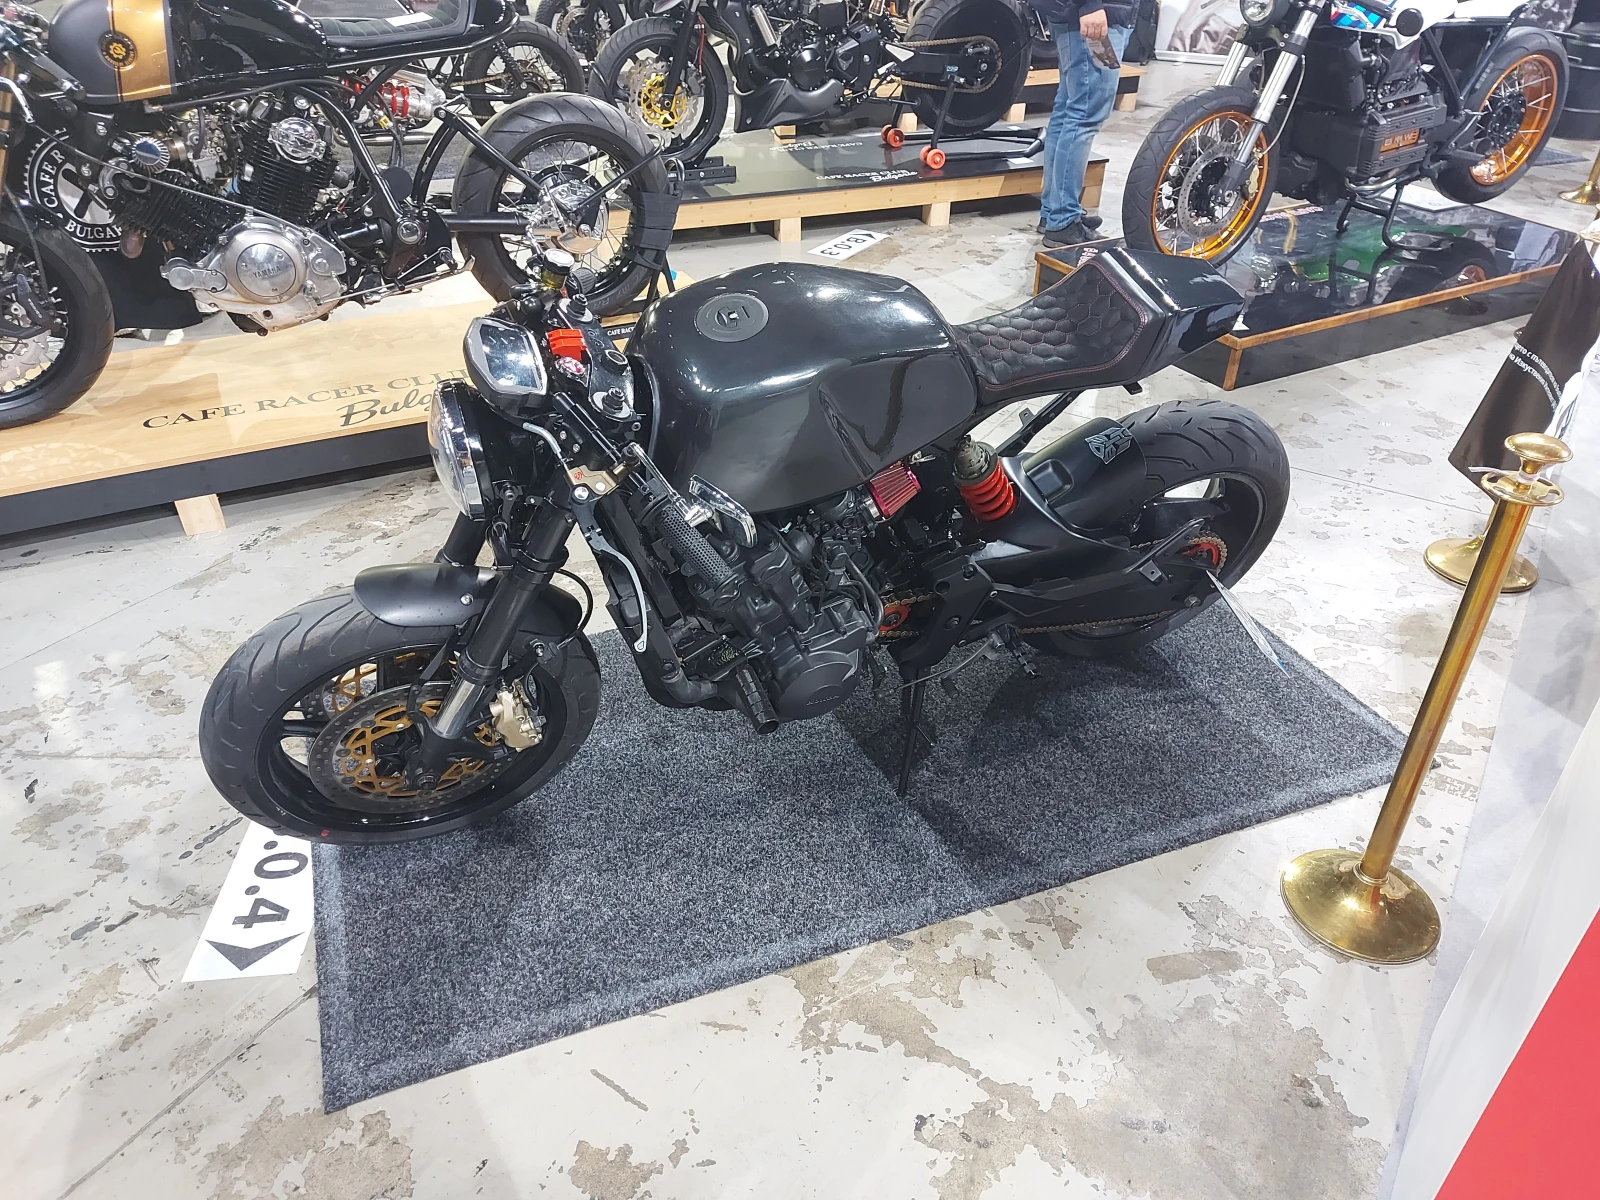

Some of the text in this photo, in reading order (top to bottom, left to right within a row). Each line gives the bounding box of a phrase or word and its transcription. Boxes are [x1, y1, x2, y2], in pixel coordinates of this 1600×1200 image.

[40, 162, 59, 208] CAFE
[820, 236, 867, 256] B.0.3
[252, 265, 281, 278] YAMAHA
[607, 327, 621, 336] CAFE
[142, 369, 470, 429] CAFE RACER CLU
[336, 389, 432, 427] Bulg
[232, 840, 309, 929] .0.4
